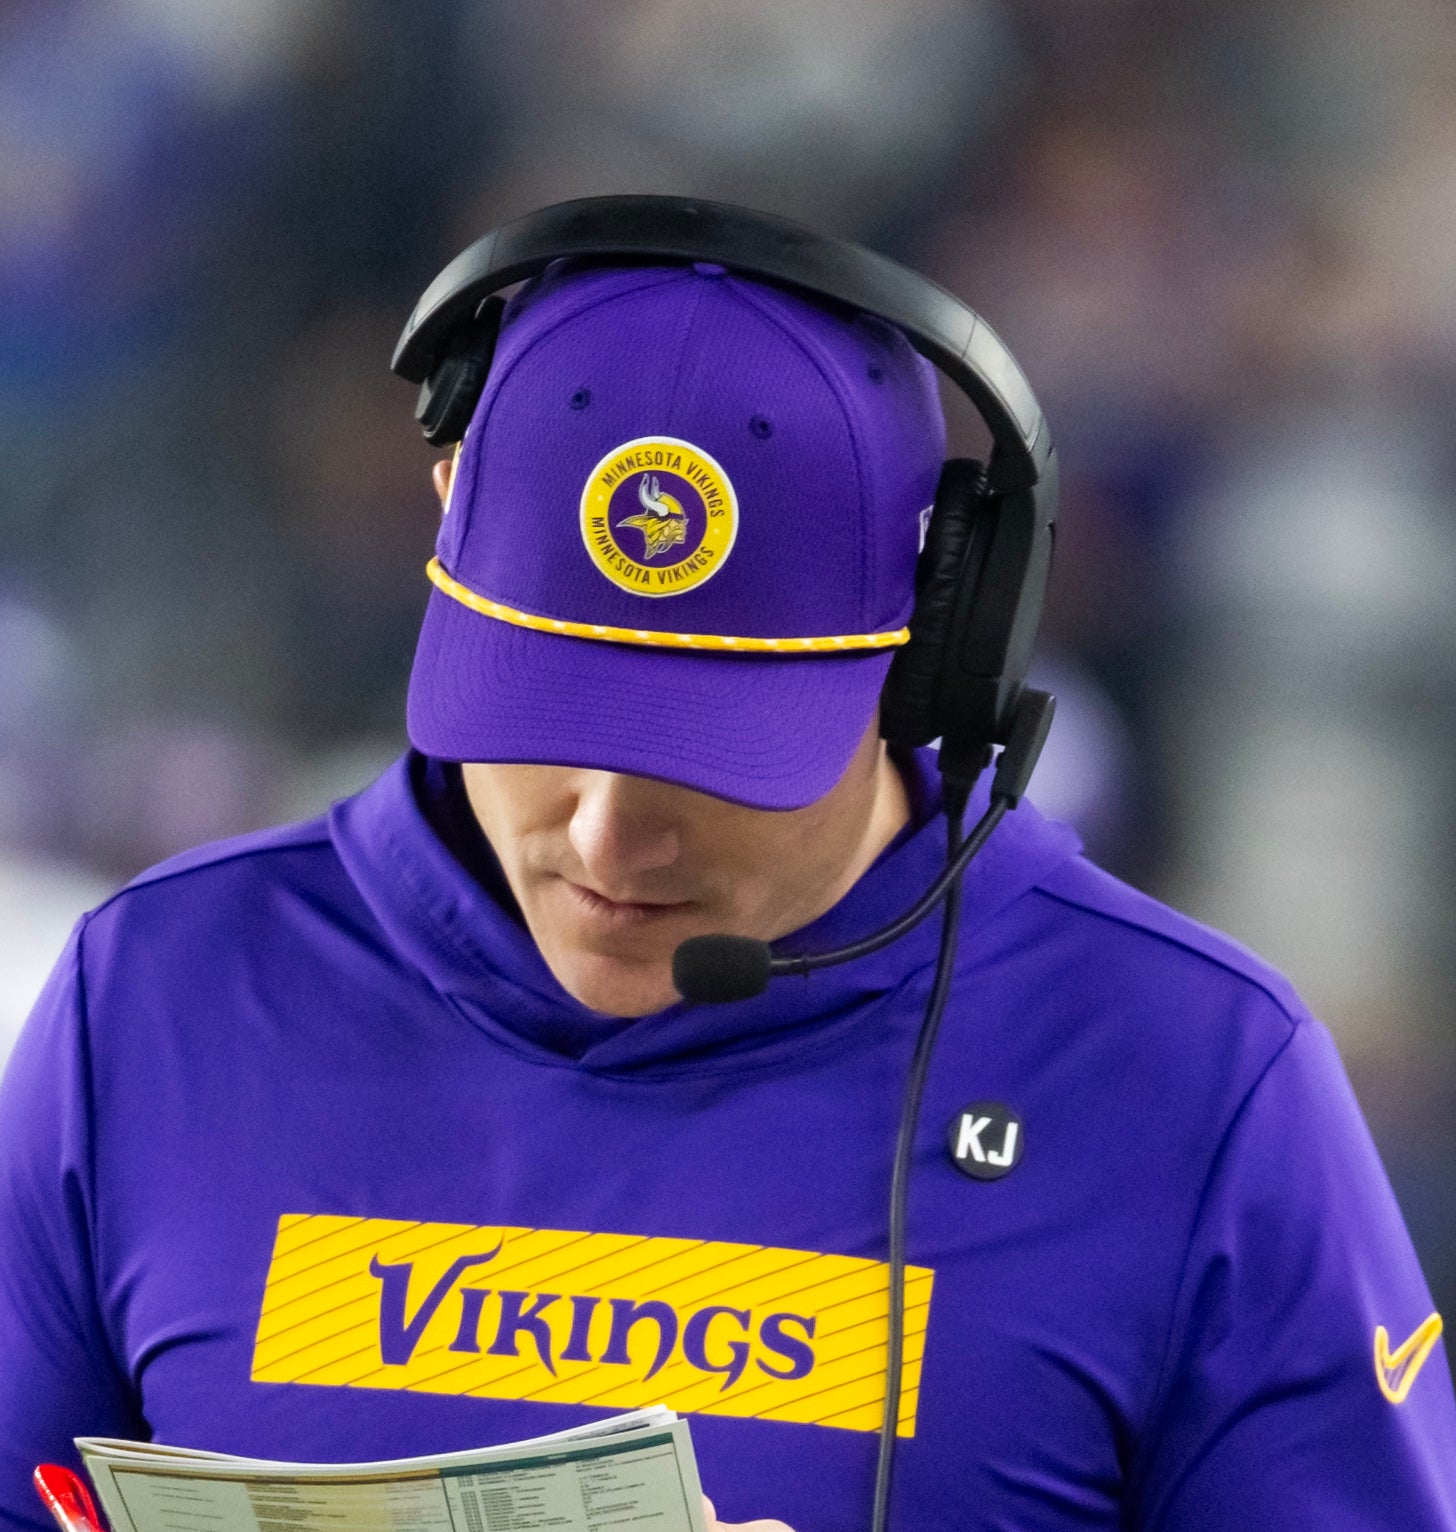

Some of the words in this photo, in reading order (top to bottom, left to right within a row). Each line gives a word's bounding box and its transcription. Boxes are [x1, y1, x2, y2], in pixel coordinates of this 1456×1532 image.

[602, 451, 682, 488] MINNESOTA
[687, 461, 725, 518] VIKINGS
[592, 517, 650, 585] MINNESOTA
[657, 546, 714, 585] VIKINGS
[954, 1113, 1019, 1168] KJ
